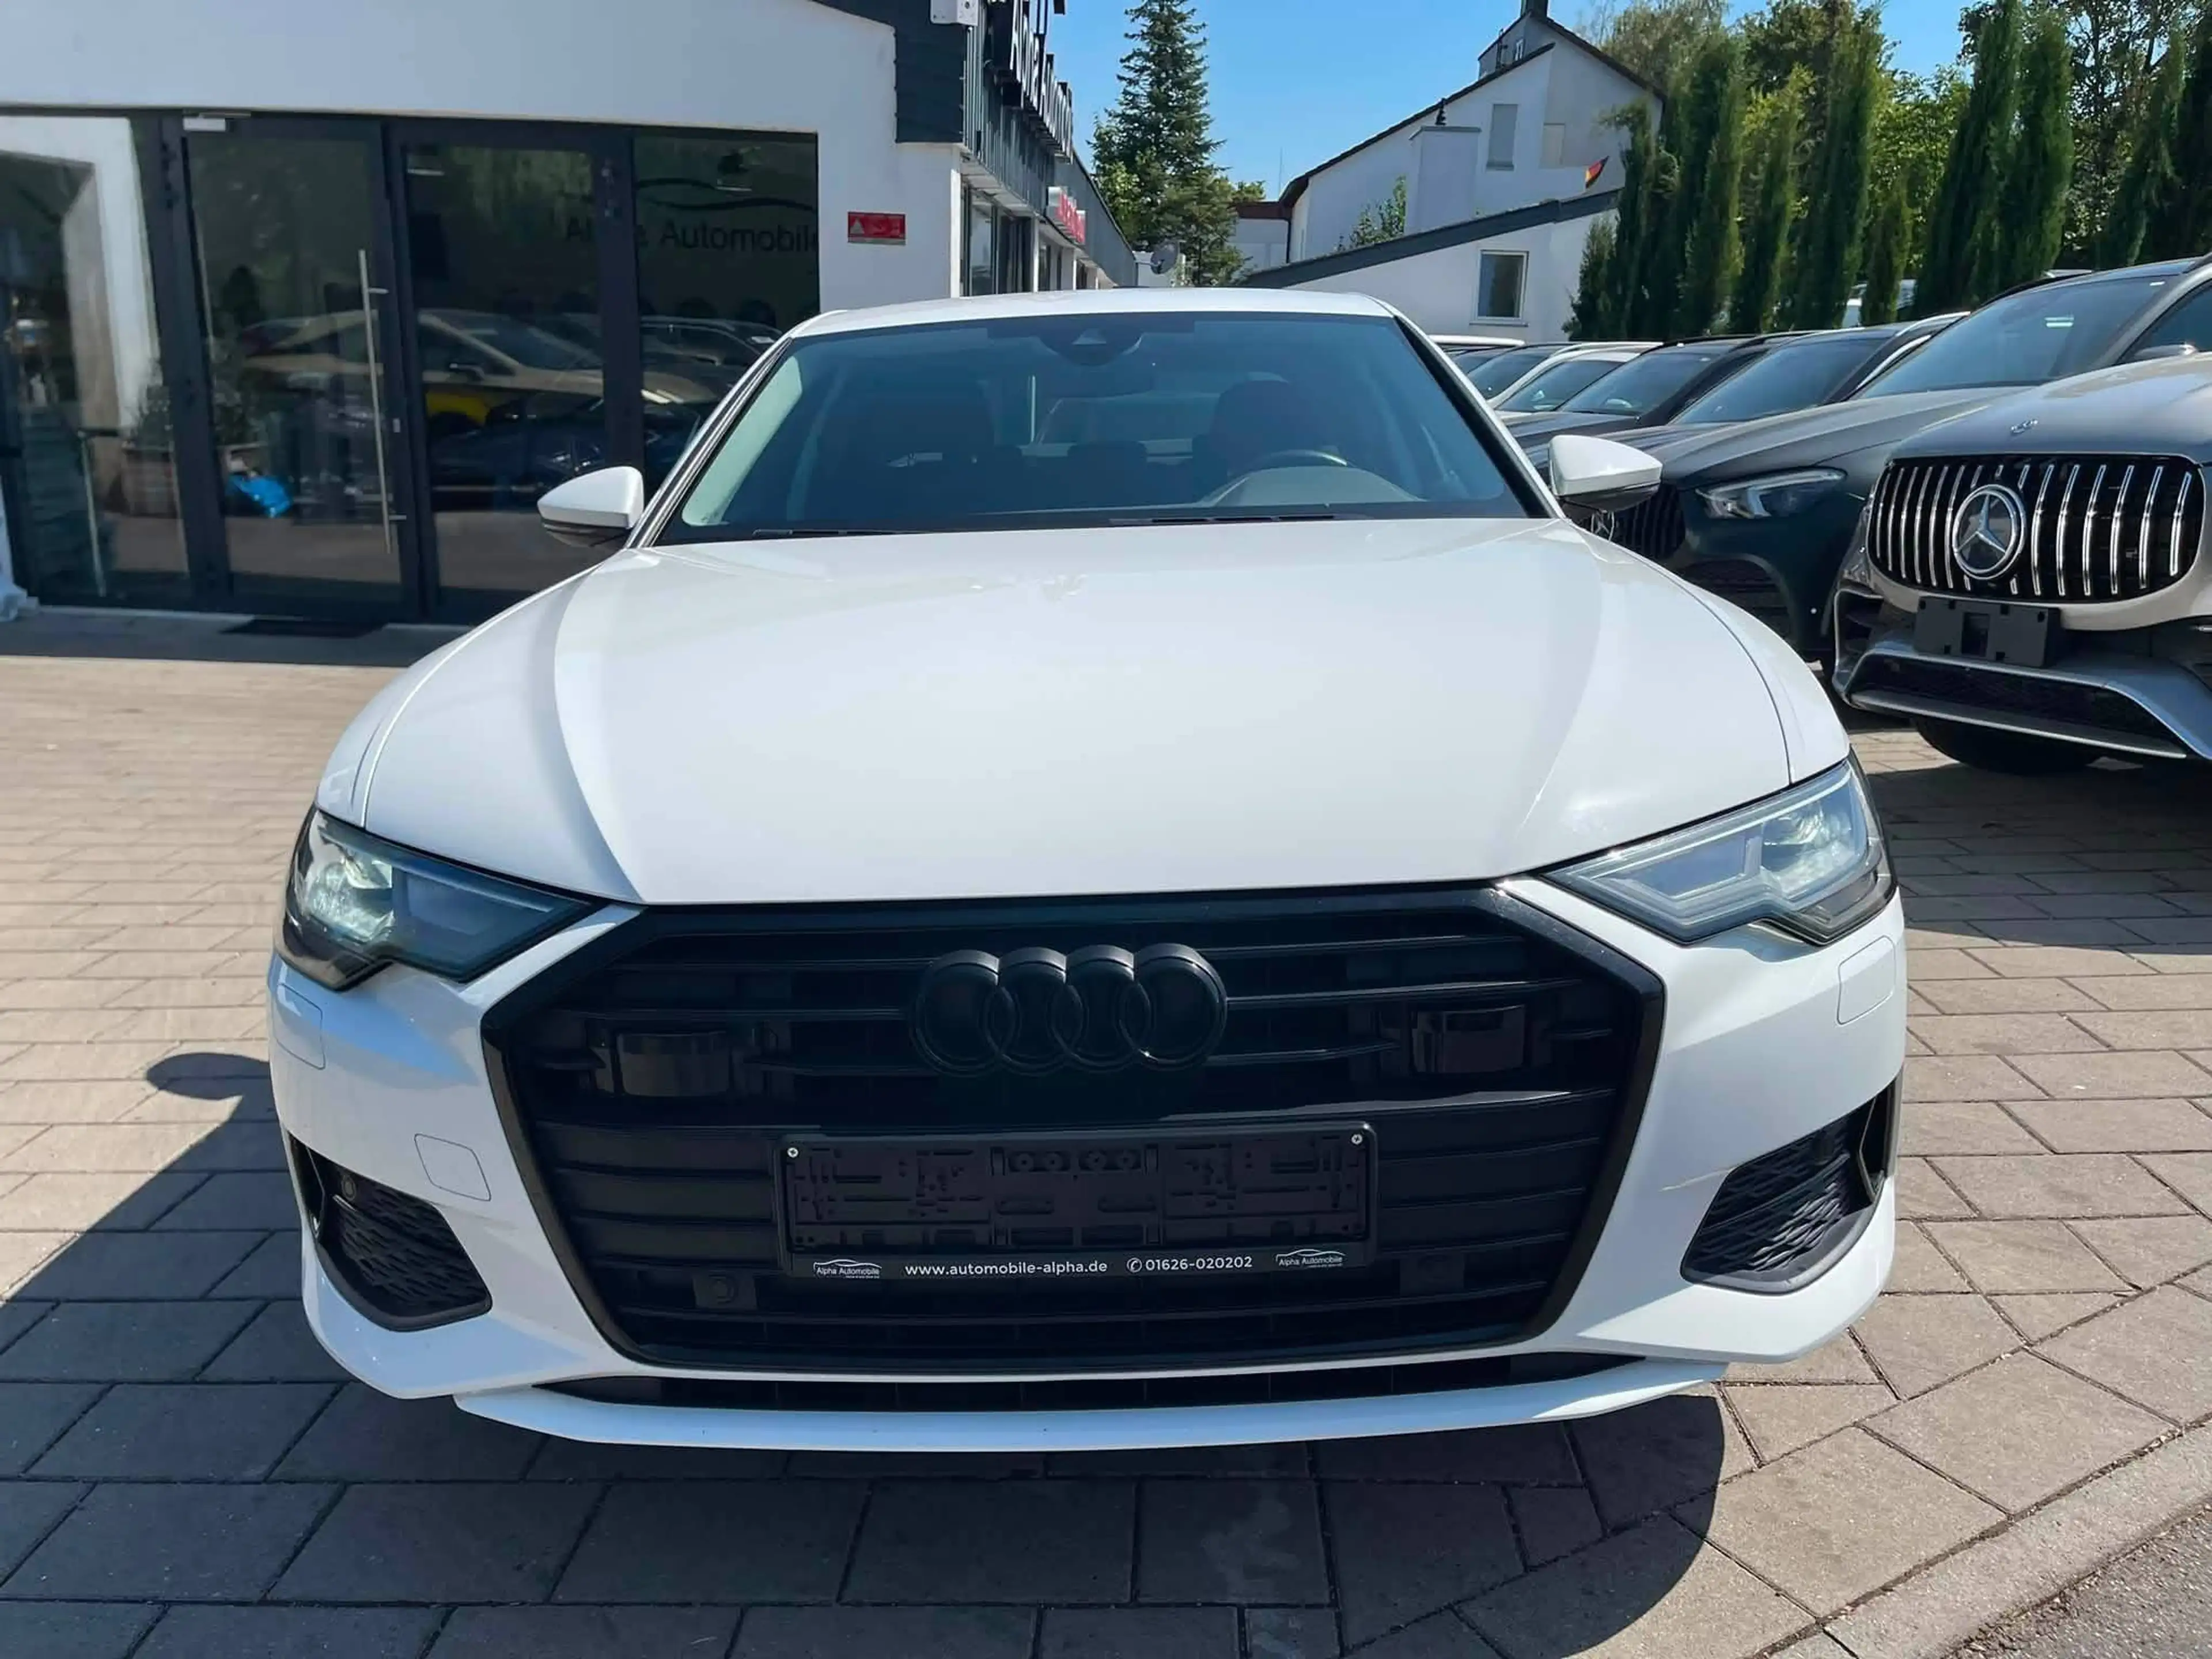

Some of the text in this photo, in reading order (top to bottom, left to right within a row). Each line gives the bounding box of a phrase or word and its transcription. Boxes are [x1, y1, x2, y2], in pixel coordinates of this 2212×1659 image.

[905, 1256, 1253, 1275] www.automobile-alpha.de 01626-020202
[1278, 1259, 1300, 1267] Alpha
[1301, 1256, 1343, 1264] Automobile
[816, 1266, 880, 1275] Alpha Automobile
